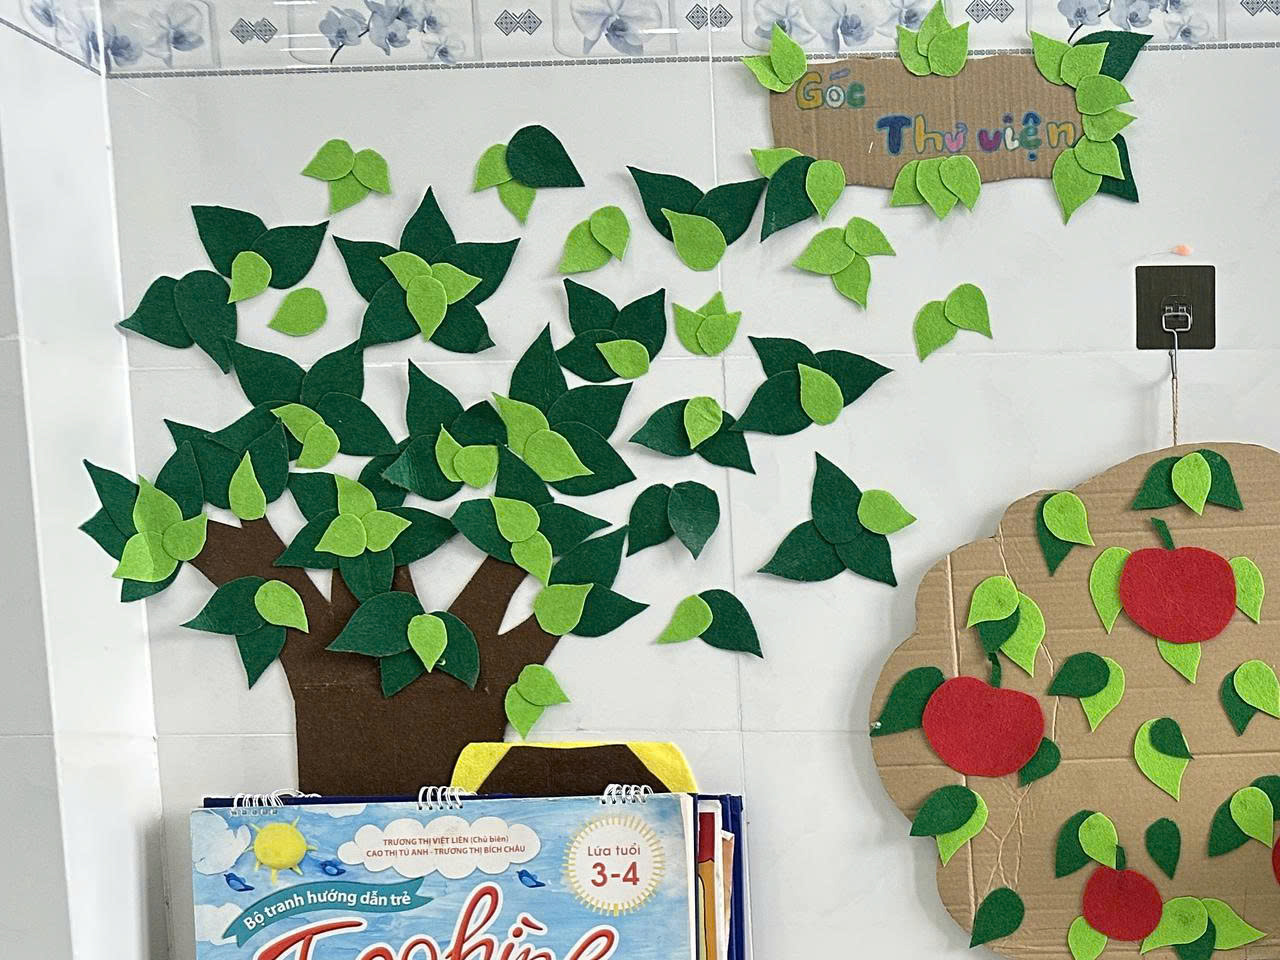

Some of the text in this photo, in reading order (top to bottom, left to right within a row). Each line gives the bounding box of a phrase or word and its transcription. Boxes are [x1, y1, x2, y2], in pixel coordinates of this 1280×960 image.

[795, 69, 866, 110] Góc
[875, 112, 1077, 161] Thư viện
[383, 837, 417, 846] TRƯƠNG
[418, 837, 431, 846] THỊ
[432, 836, 449, 845] VIỆT
[451, 836, 469, 844] LIÊN
[489, 835, 509, 843] biên)
[384, 849, 397, 858] THỊ
[411, 848, 429, 856] ANH
[434, 846, 468, 855] TRƯƠNG
[469, 846, 482, 855] THỊ
[483, 845, 502, 854] BÍCH
[503, 844, 526, 853] CHÂU
[587, 842, 641, 856] Lứa tuổi
[591, 861, 640, 887] 3-4
[243, 889, 412, 930] Bộ tranh hướng dẫn trẻ
